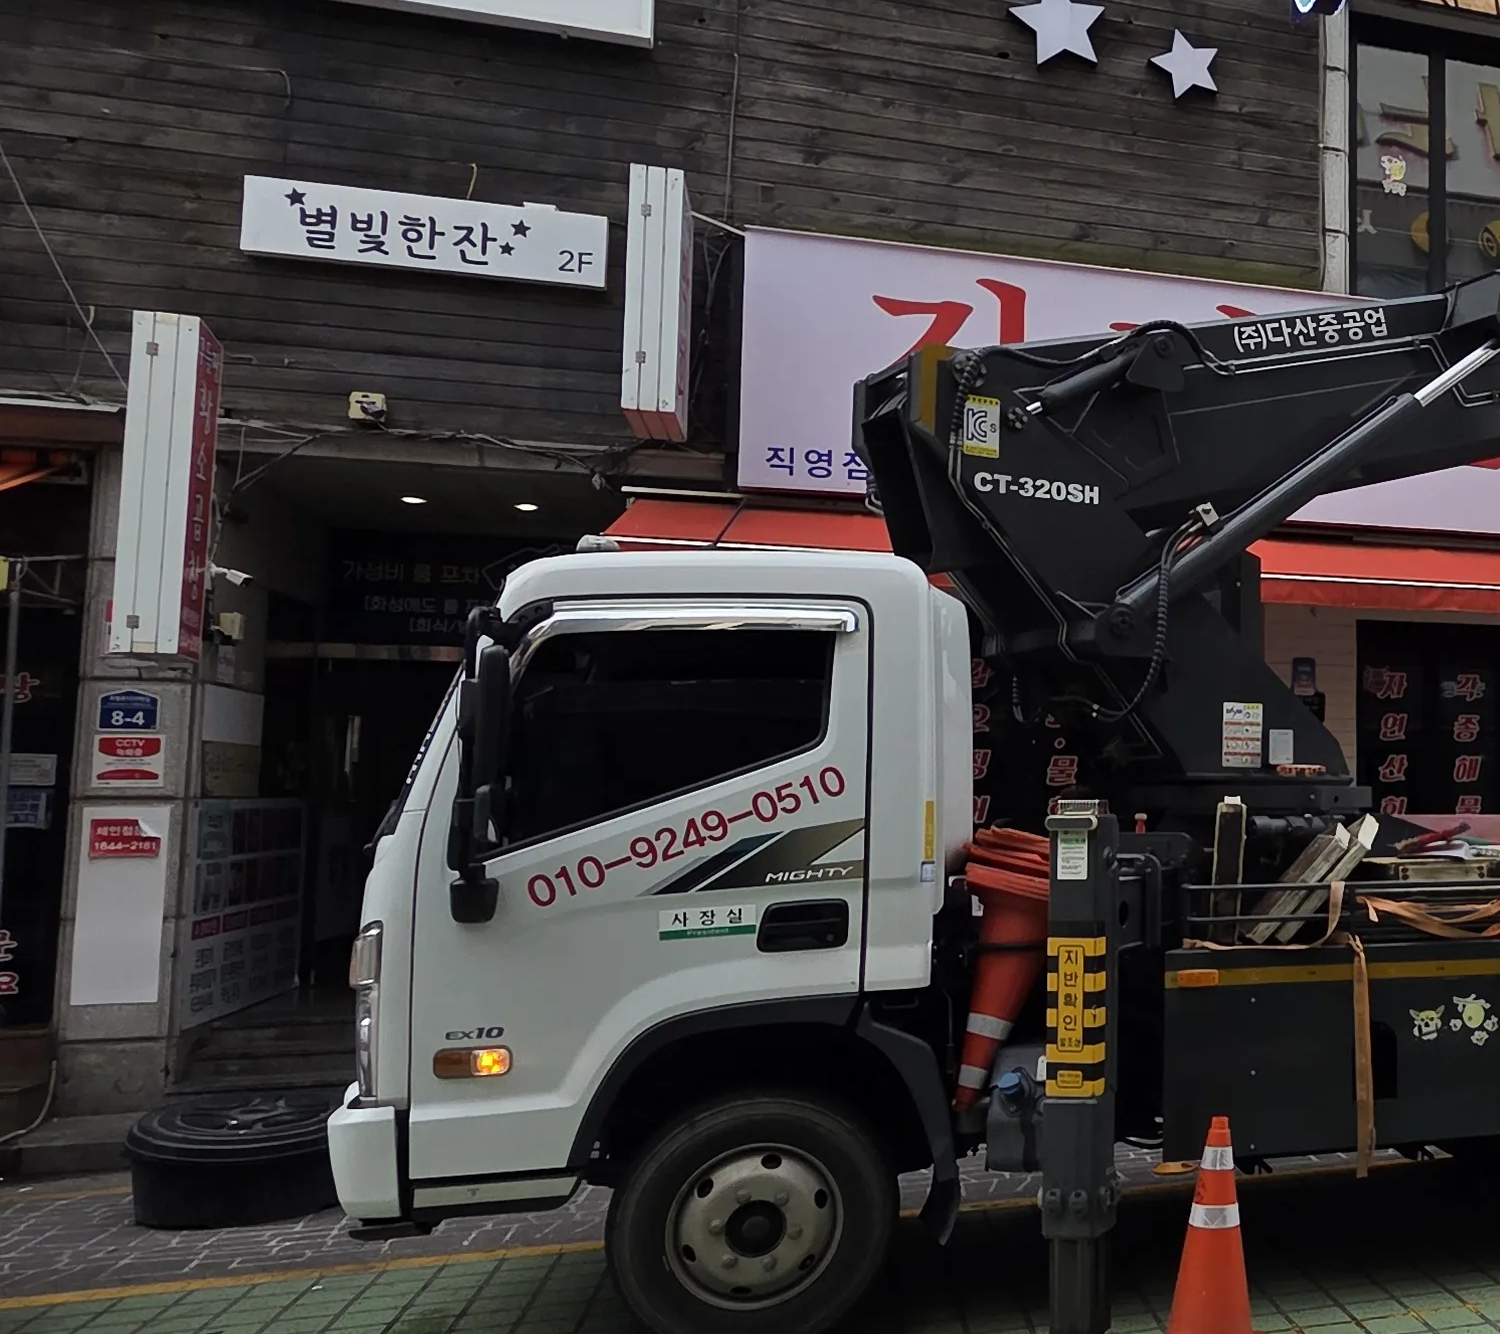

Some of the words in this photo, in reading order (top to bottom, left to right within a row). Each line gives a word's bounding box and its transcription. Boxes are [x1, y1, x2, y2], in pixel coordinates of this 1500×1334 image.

[298, 204, 499, 267] 별빛한잔
[557, 249, 595, 274] 2F
[1233, 307, 1389, 354] (주)다산중공업
[973, 471, 1101, 505] CT-320SH
[110, 710, 146, 727] 8-4
[115, 738, 146, 748] CCTV
[526, 766, 847, 907] 010-9249-0510
[764, 866, 855, 884] MIGHTY
[671, 907, 744, 929] 사장실
[1062, 949, 1079, 1032] 지반확인
